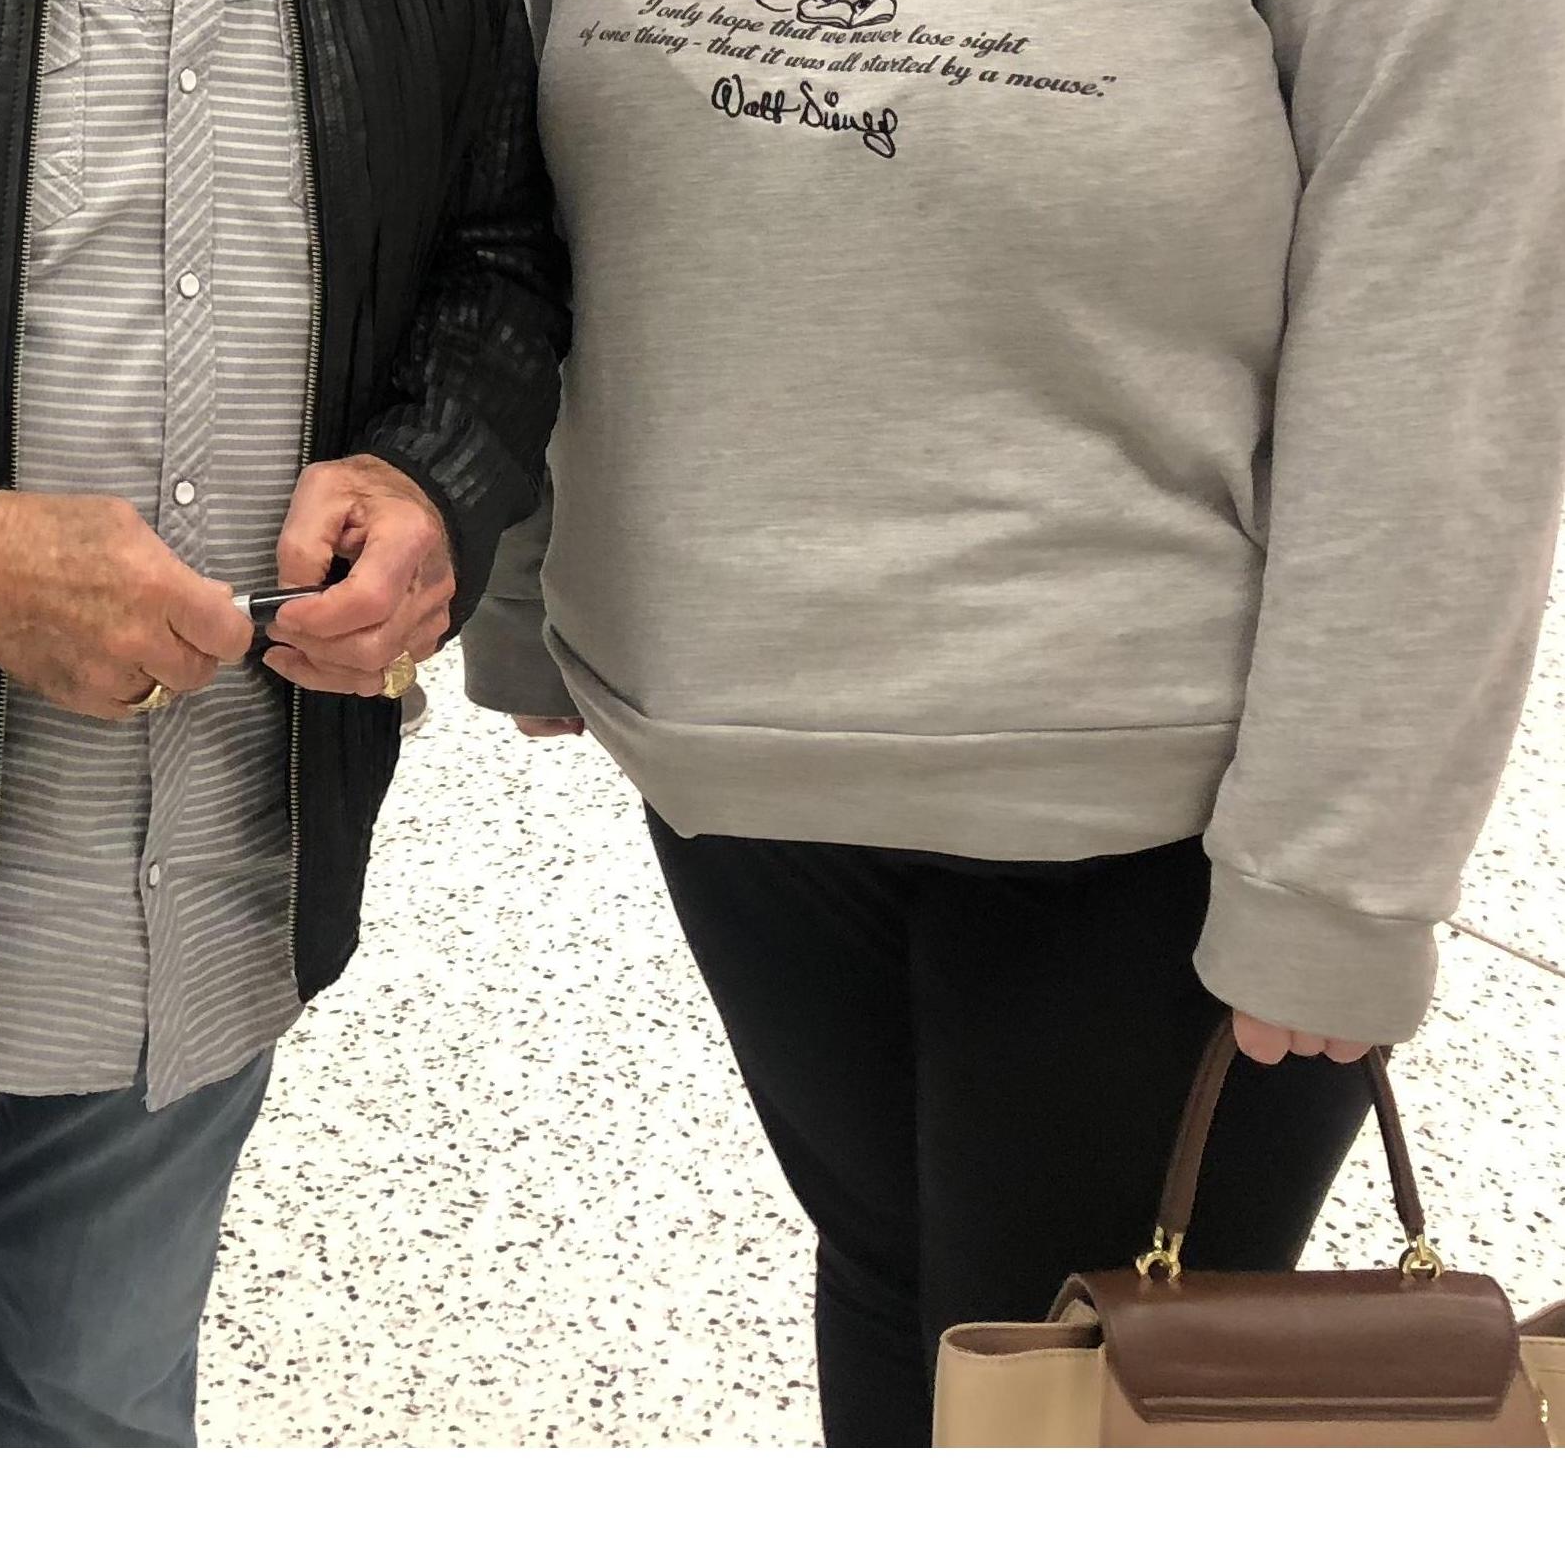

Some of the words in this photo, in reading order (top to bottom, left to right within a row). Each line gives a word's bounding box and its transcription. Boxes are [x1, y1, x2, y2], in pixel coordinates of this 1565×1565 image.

[580, 20, 601, 47] of
[599, 28, 631, 43] one
[634, 25, 689, 55] thing
[707, 34, 762, 61] that
[760, 47, 787, 65] it
[784, 55, 826, 71] was
[826, 52, 863, 72] all
[859, 53, 943, 75] started
[940, 55, 973, 86] by
[978, 68, 1000, 83] a
[1005, 72, 1118, 98] mouse."
[656, 2, 703, 28] only
[707, 5, 764, 35] hope
[769, 18, 822, 41] that
[820, 29, 847, 44] we
[849, 27, 903, 45] never
[907, 24, 956, 47] lose
[959, 31, 1031, 58] sight
[711, 73, 801, 125] Walt
[798, 80, 898, 159] Disney
